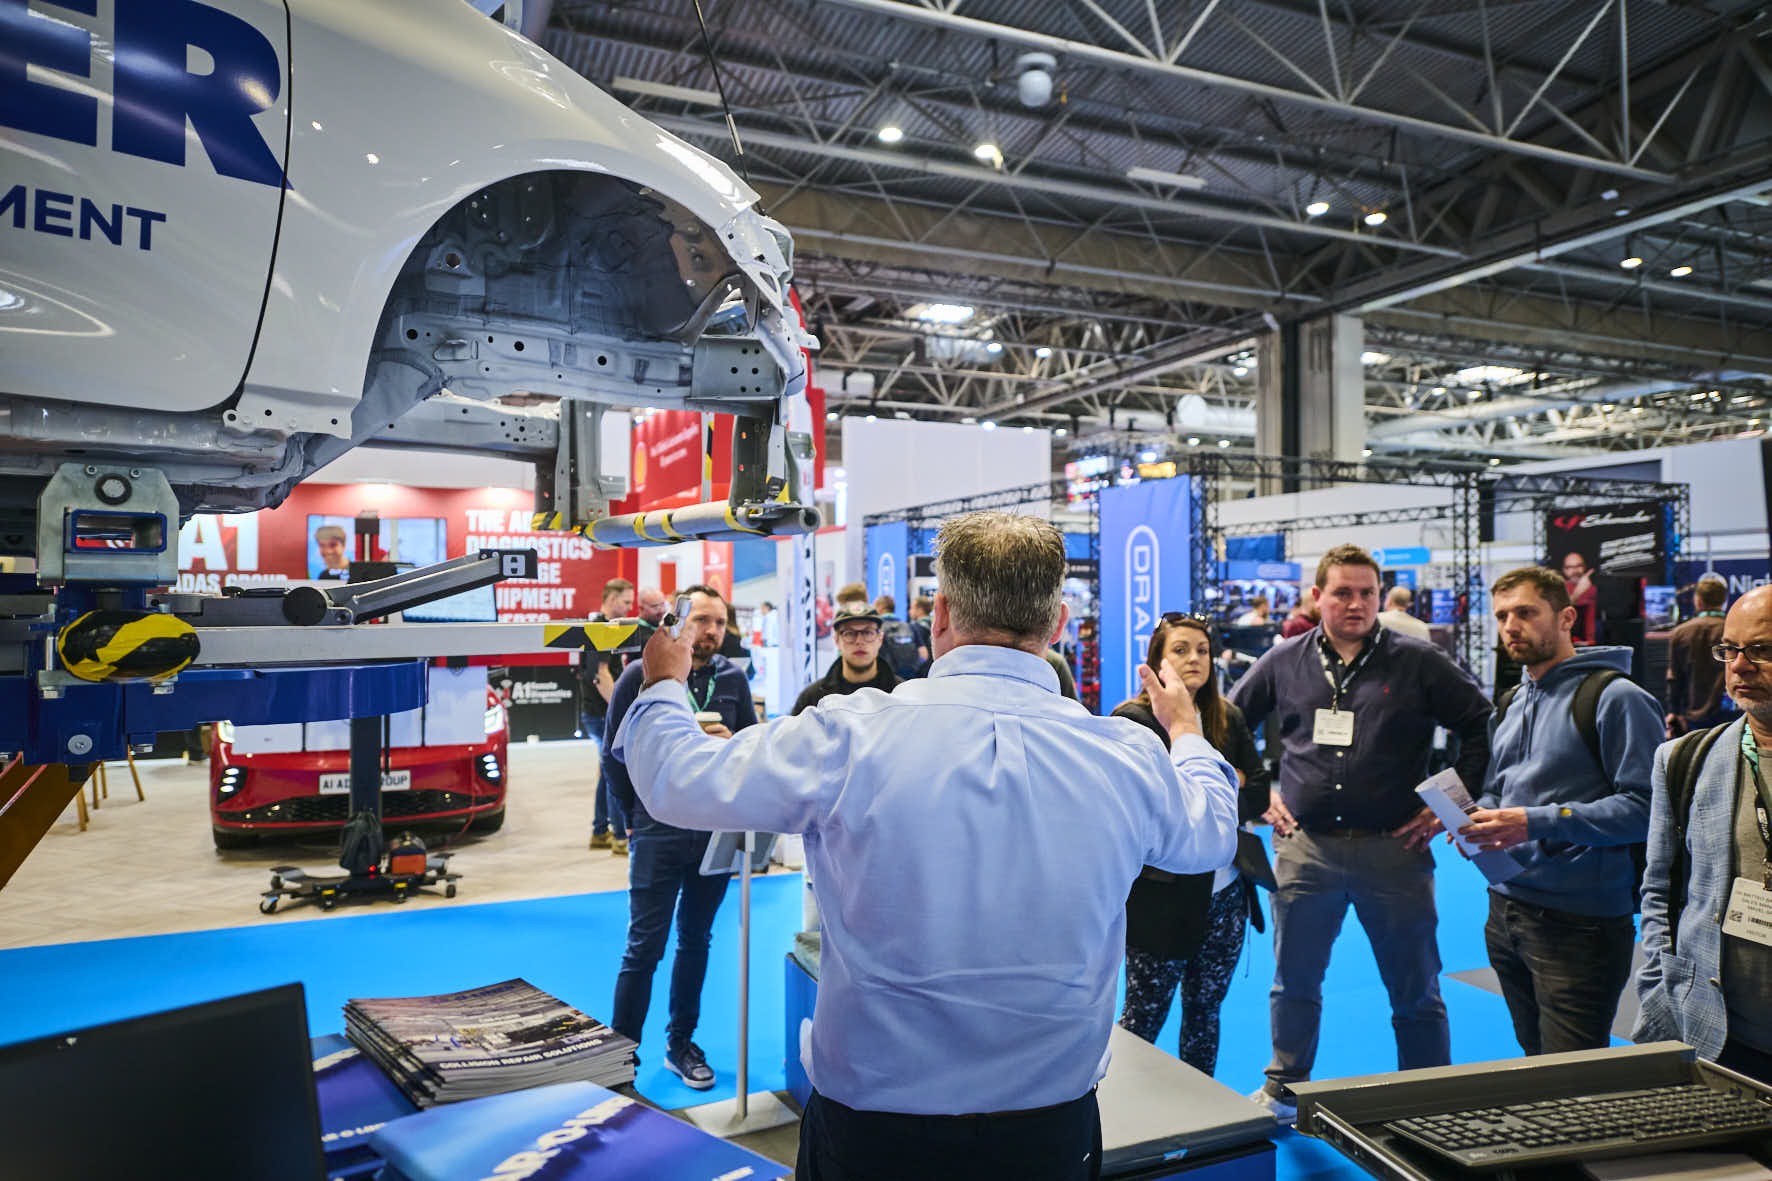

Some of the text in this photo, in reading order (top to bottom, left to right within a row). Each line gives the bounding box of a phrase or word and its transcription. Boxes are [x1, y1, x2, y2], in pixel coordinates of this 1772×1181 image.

[178, 510, 259, 571] A1
[439, 1039, 602, 1069] COLLISION REPAIR SOLUTIONS
